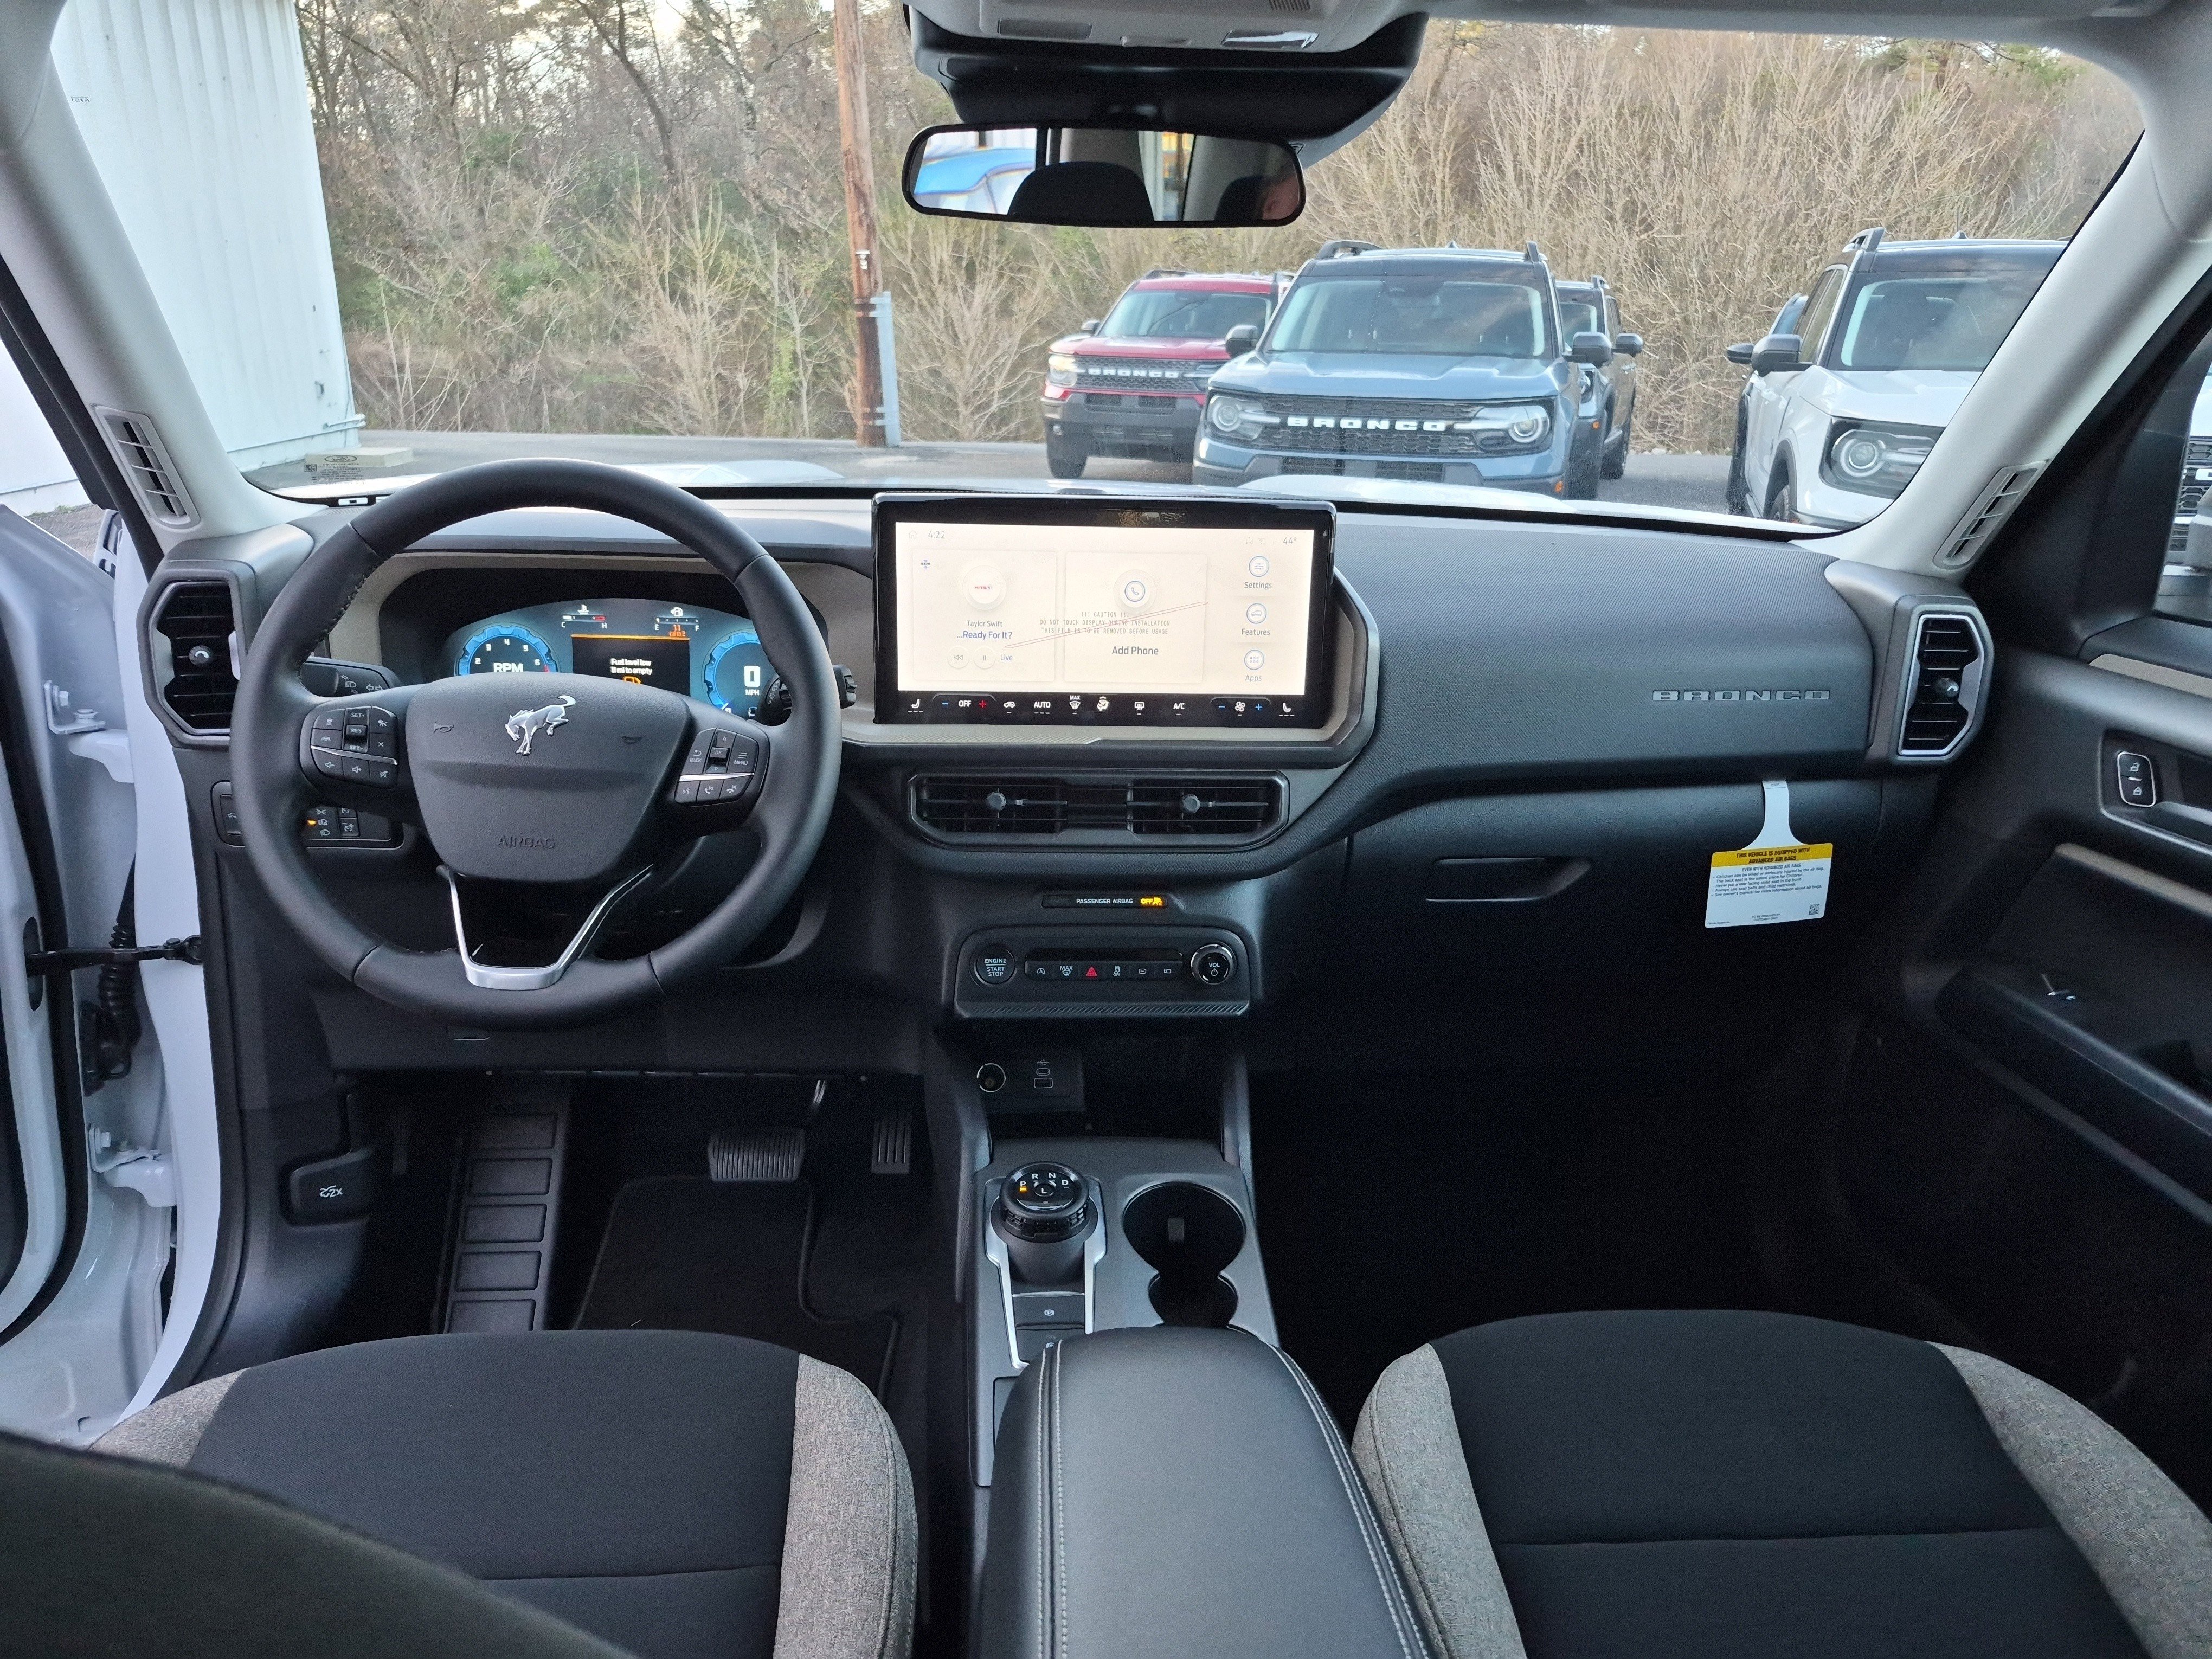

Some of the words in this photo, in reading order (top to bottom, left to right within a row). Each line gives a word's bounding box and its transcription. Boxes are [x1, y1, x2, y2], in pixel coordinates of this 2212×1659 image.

[1088, 368, 1179, 378] BRONCO
[1287, 416, 1446, 431] BRONCO
[928, 531, 946, 539] 4:22
[1244, 582, 1272, 590] Settings
[1002, 631, 1012, 639] It?
[1111, 646, 1129, 655] Add
[1131, 646, 1159, 655] Phone
[610, 658, 625, 666] Fuel
[625, 658, 640, 666] level
[493, 663, 524, 673] RPM
[633, 667, 653, 676] empty
[744, 665, 761, 687] 0
[1652, 690, 1830, 702] BRONCO
[498, 835, 555, 850] AIRBAG
